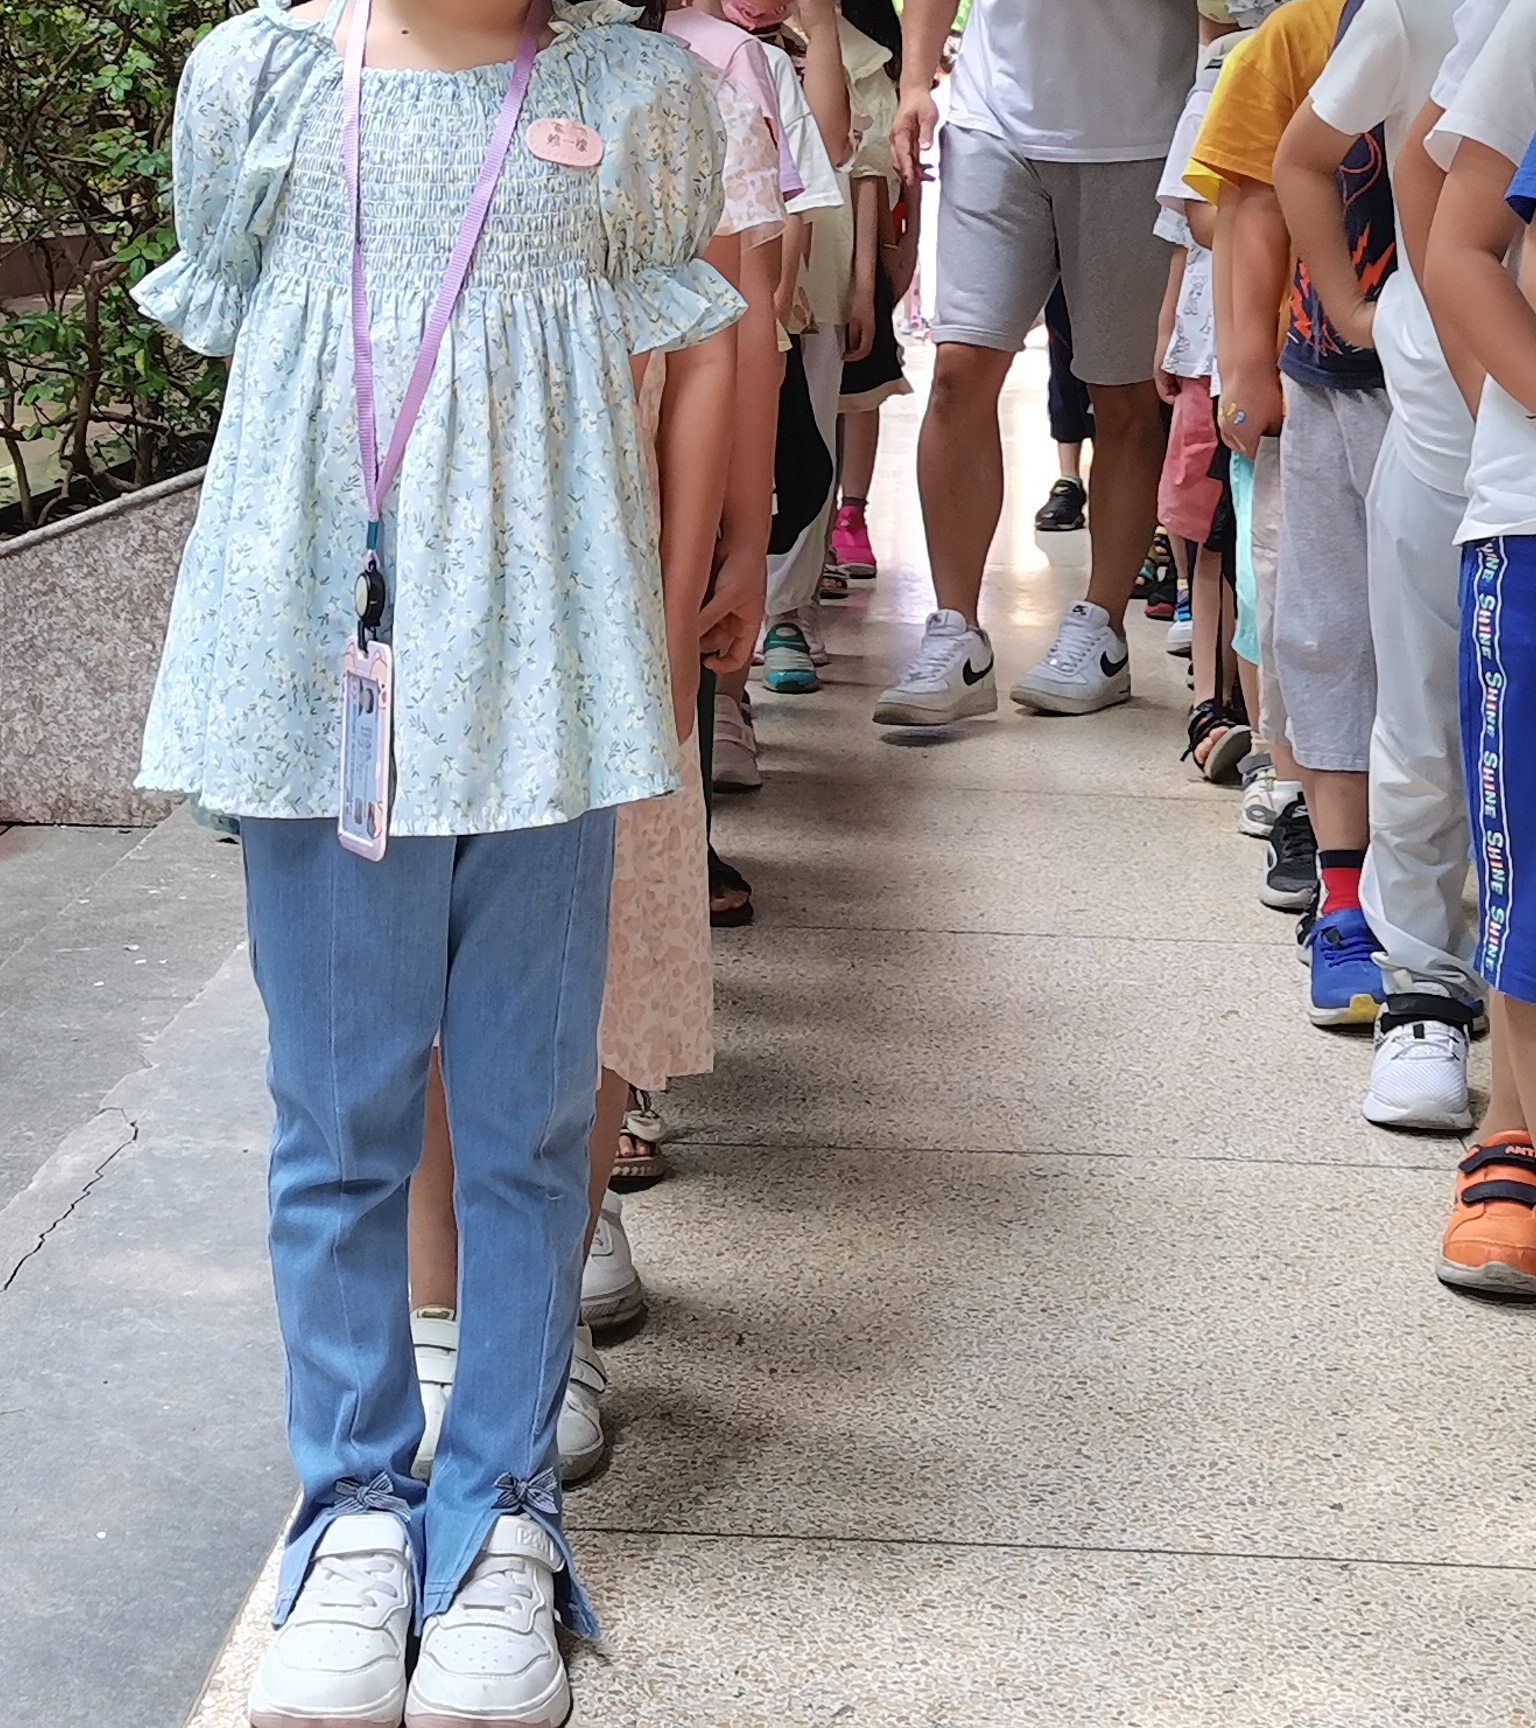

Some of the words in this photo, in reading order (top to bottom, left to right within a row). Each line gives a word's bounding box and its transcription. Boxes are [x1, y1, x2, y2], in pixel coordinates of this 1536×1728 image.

[1480, 540, 1500, 584] HINE
[1478, 593, 1496, 660] SHINE
[1485, 671, 1503, 740] SHINE
[1482, 750, 1498, 819] SHINE
[1486, 829, 1506, 896] SHINE
[1484, 904, 1505, 973] SHINE
